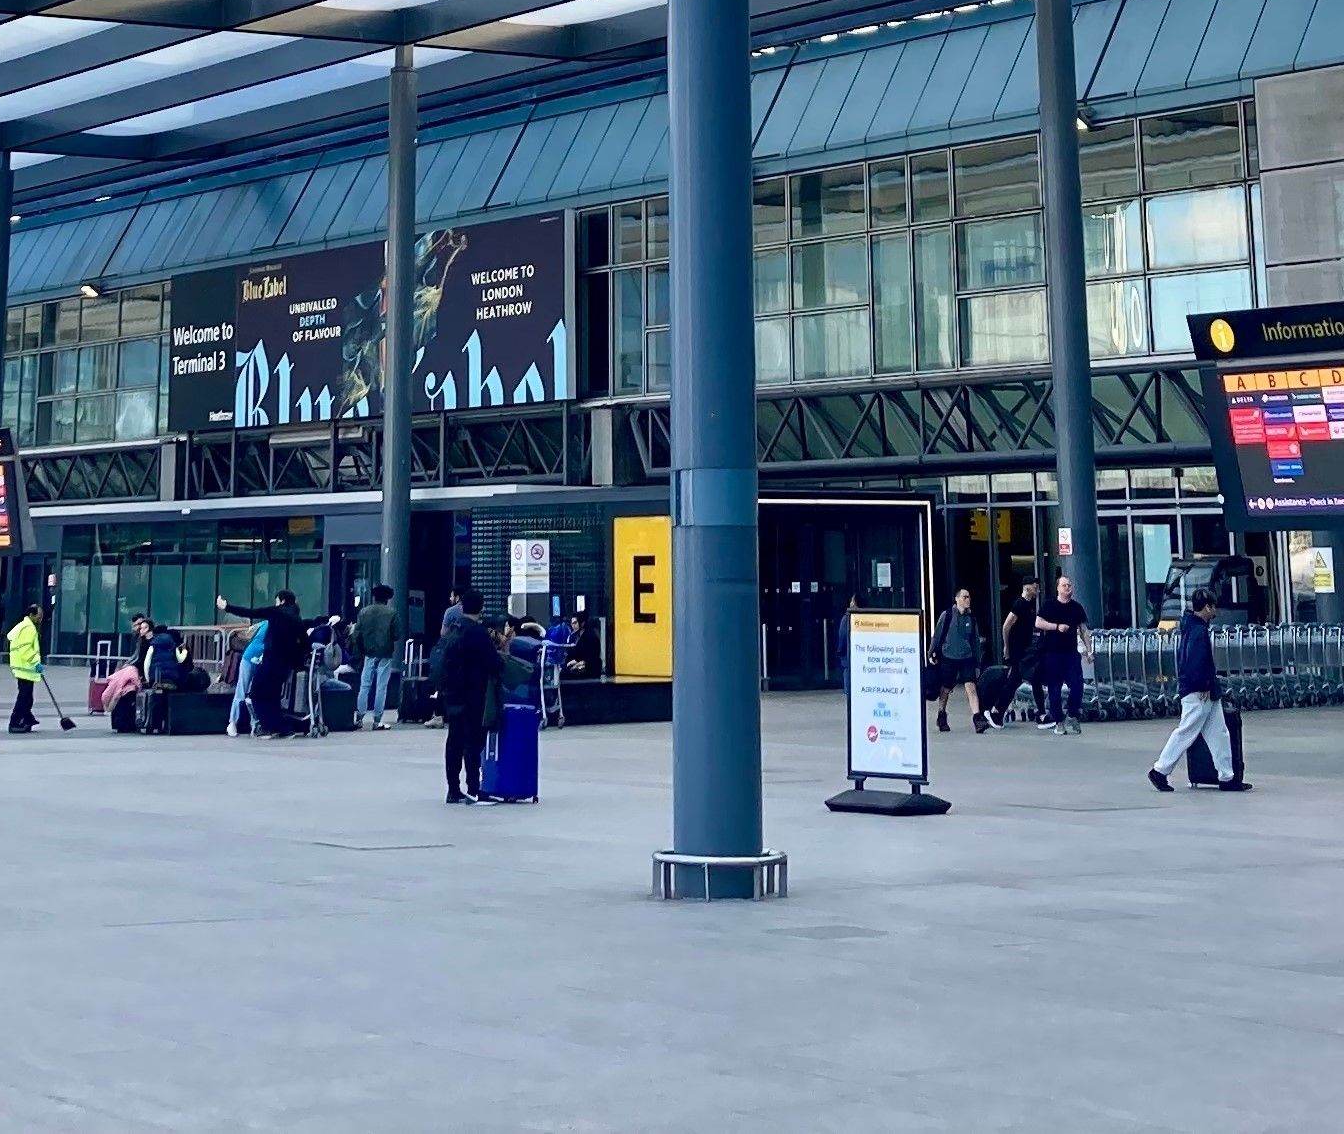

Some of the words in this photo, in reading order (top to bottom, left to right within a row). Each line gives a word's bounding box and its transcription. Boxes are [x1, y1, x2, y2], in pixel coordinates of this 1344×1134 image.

[471, 267, 519, 285] WELCOME
[520, 264, 535, 278] TO
[482, 284, 523, 302] LONDON
[289, 298, 337, 314] UNRIVALLED
[476, 301, 532, 320] HEATHROW
[299, 314, 326, 327] DEPTH
[173, 323, 220, 346] Welcome
[222, 322, 234, 341] to
[292, 330, 304, 343] OF
[305, 325, 341, 341] FLAVOUR
[173, 351, 217, 376] Terminal
[218, 351, 226, 371] 3
[1237, 376, 1246, 390] A
[1268, 374, 1276, 388] B
[1299, 372, 1308, 386] C
[1332, 370, 1341, 384] D
[633, 555, 657, 624] E
[856, 644, 865, 652] The
[866, 644, 894, 655] following
[873, 709, 892, 718] KLM
